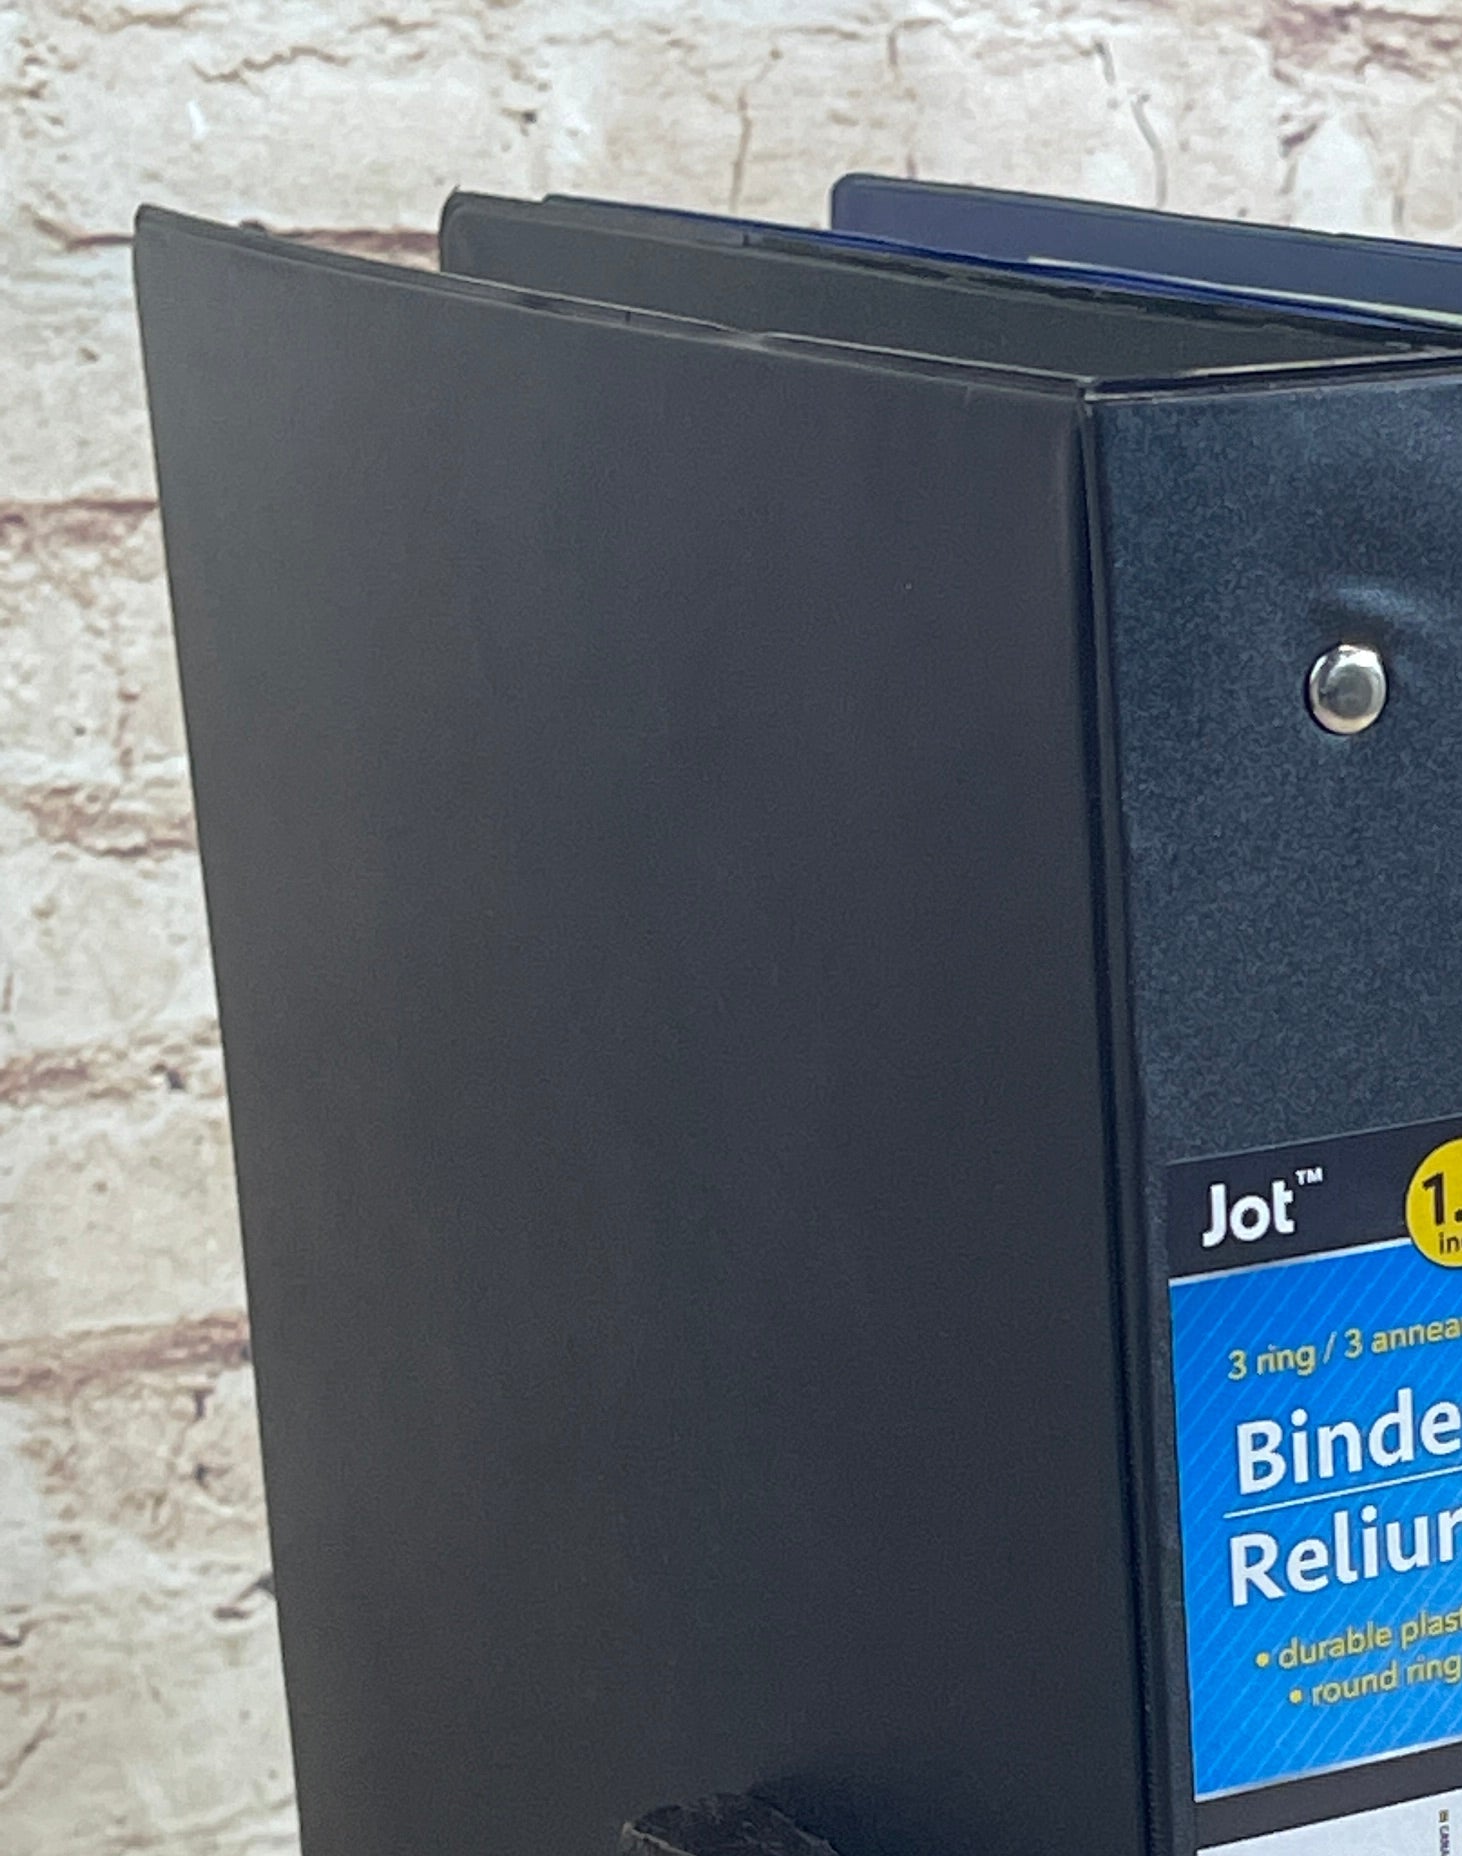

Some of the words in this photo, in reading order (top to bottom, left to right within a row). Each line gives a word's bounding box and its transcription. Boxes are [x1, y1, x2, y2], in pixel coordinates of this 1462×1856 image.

[1228, 1349, 1247, 1380] 3
[1256, 1344, 1316, 1378] ring
[1323, 1331, 1337, 1363] /
[1344, 1328, 1363, 1359] 3
[1277, 1622, 1392, 1669] durable
[1311, 1665, 1398, 1706] round
